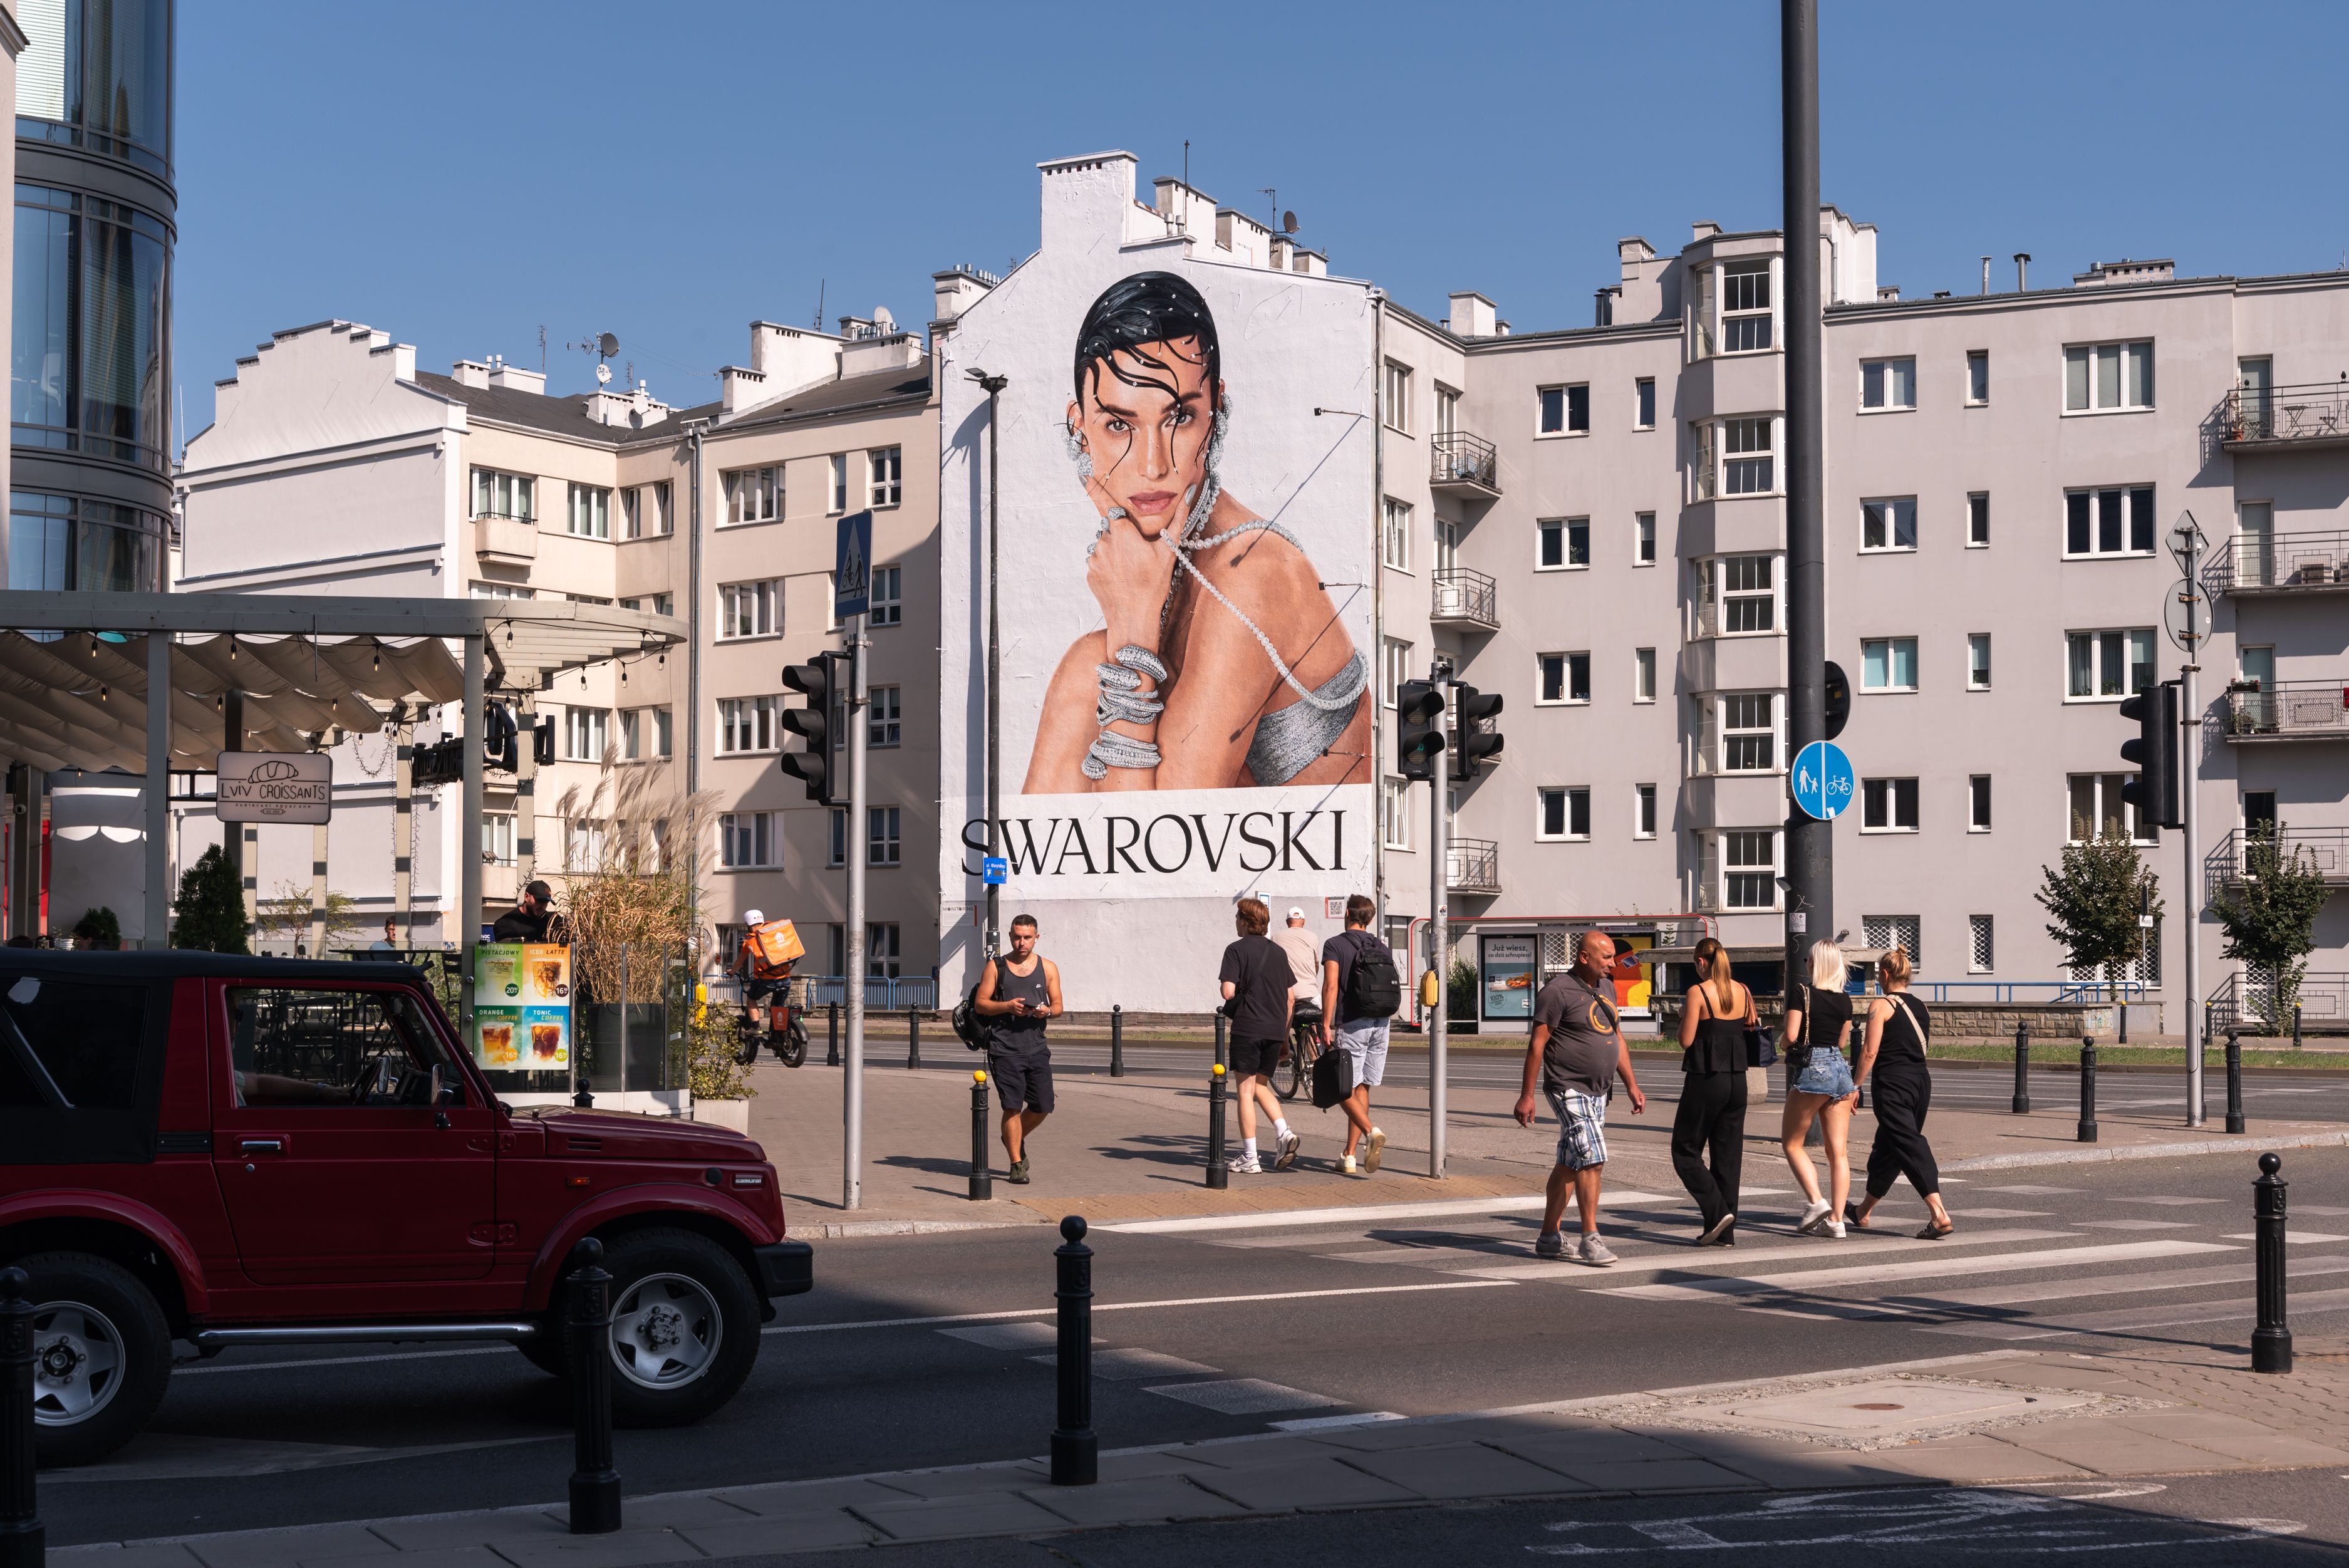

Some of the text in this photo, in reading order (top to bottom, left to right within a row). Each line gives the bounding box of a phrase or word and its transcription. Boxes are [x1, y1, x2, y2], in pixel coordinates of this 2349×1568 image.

[221, 781, 325, 800] Lviv CROISSANTS
[961, 810, 1347, 876] SWAROVSKI
[1490, 993, 1504, 1002] 100%
